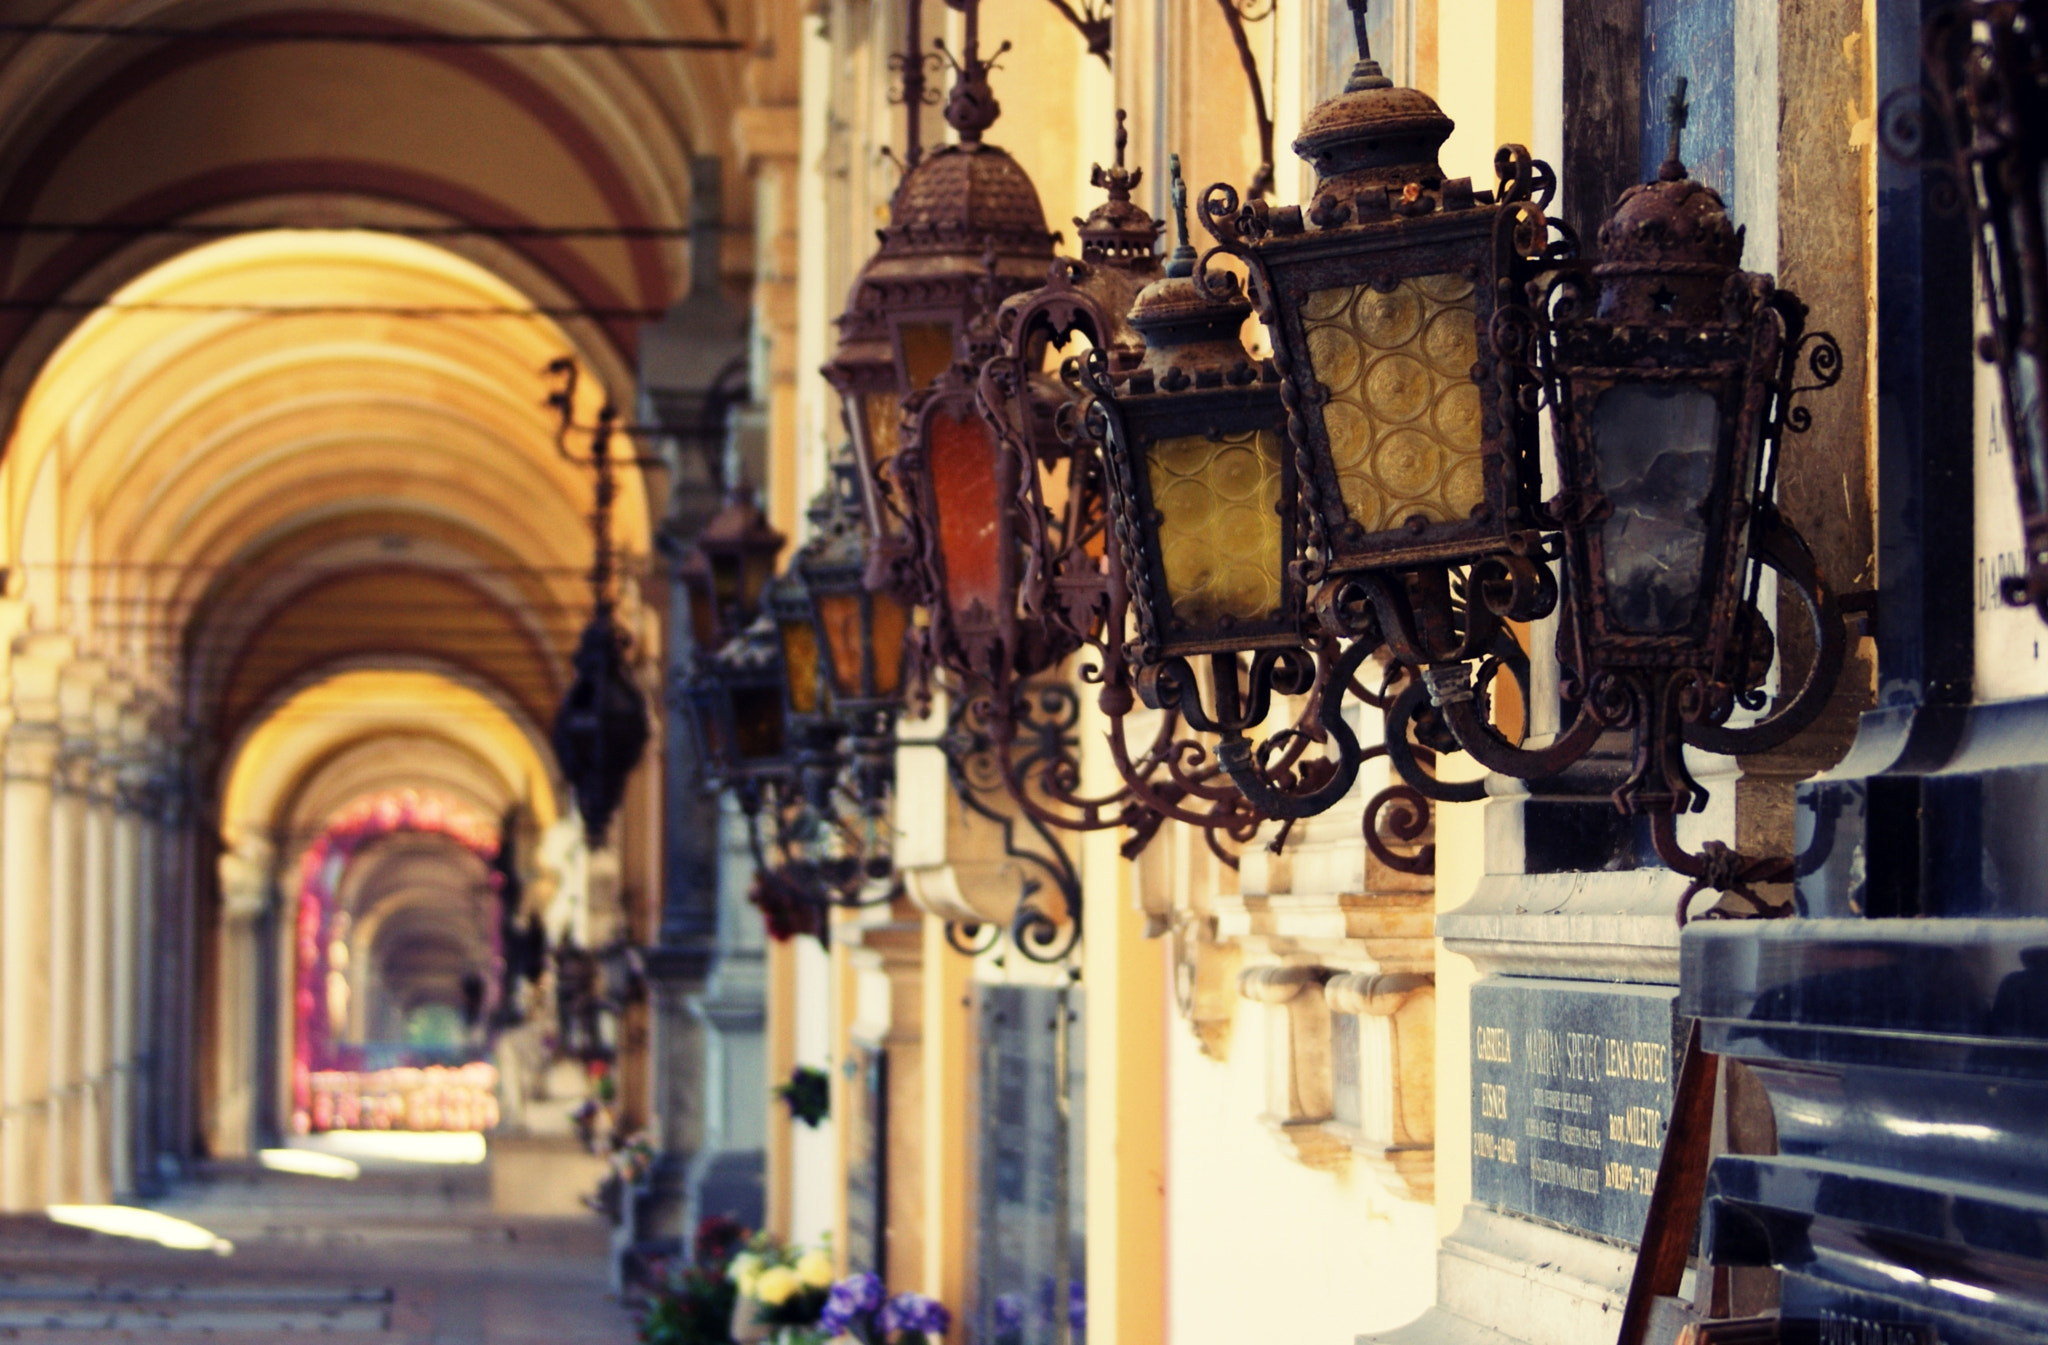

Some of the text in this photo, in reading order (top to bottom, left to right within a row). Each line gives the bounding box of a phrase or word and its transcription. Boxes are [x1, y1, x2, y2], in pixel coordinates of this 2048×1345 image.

[1476, 1026, 1511, 1063] GABRIELA
[1567, 1032, 1601, 1082] SPEVEC
[1605, 1038, 1667, 1083] LENA SPEVEC
[1482, 1082, 1507, 1119] EISNER
